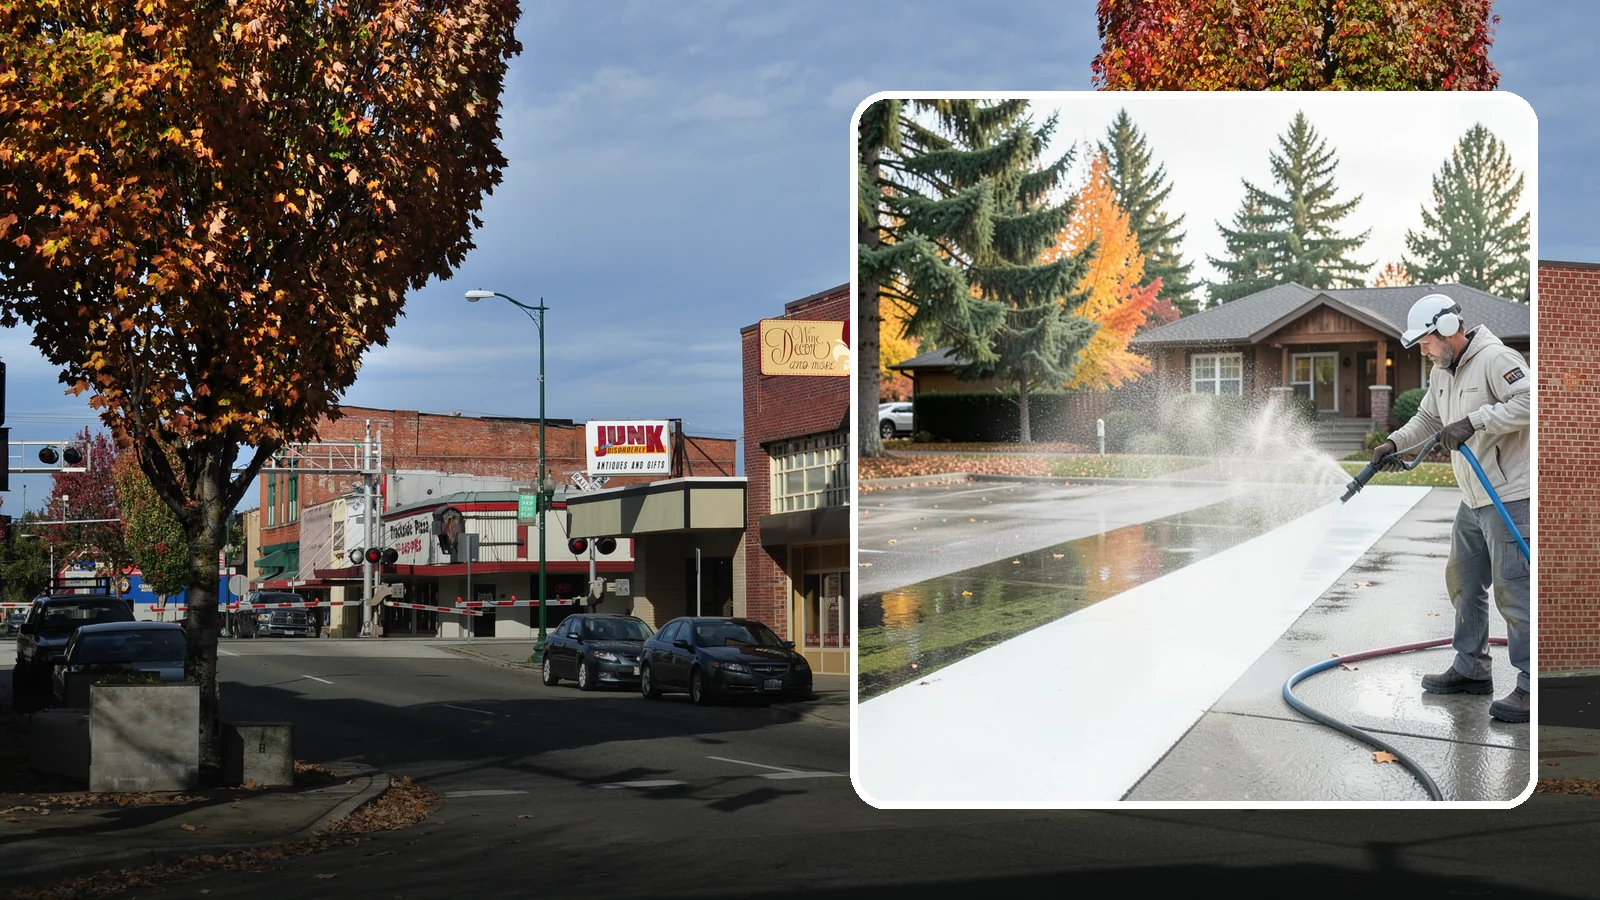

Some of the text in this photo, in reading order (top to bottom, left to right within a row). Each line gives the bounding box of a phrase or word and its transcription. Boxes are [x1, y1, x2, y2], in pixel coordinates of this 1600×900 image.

[596, 425, 664, 457] JUNK
[597, 460, 665, 470] ANTIQUES AND GIFTS
[573, 473, 588, 492] RAIL
[414, 520, 429, 534] Pizza
